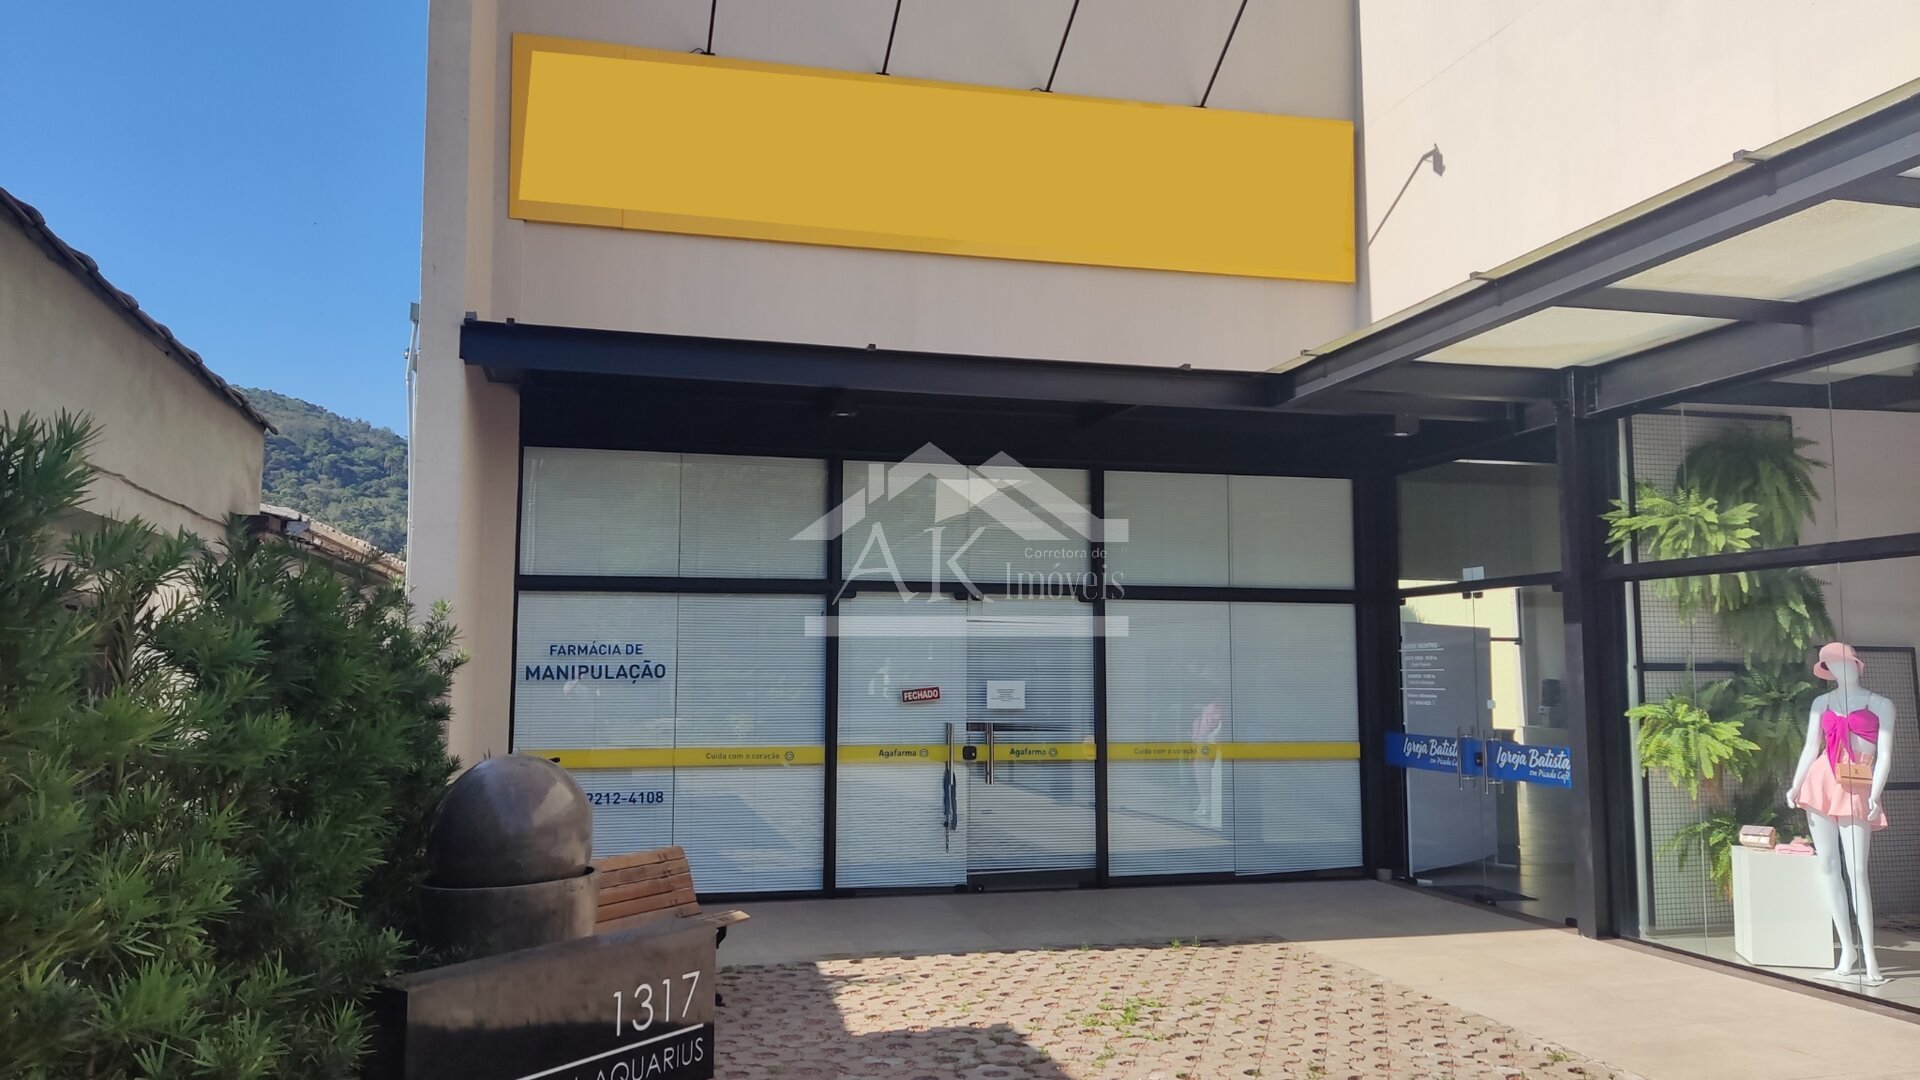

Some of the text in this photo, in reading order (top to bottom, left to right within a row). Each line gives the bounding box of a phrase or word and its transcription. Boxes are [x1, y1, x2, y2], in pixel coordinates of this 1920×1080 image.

[550, 640, 644, 656] FARMÁCIA DE
[525, 660, 666, 684] MANIPULAÇÃO
[903, 689, 939, 701] FECHADO
[878, 748, 917, 759] Agafarma
[1010, 747, 1046, 757] Agafarma
[1403, 737, 1428, 759] Igreja
[706, 752, 727, 760] Cuida
[752, 752, 780, 761] coração
[1496, 746, 1571, 771] Igreja Batista
[612, 970, 700, 1037] 1317
